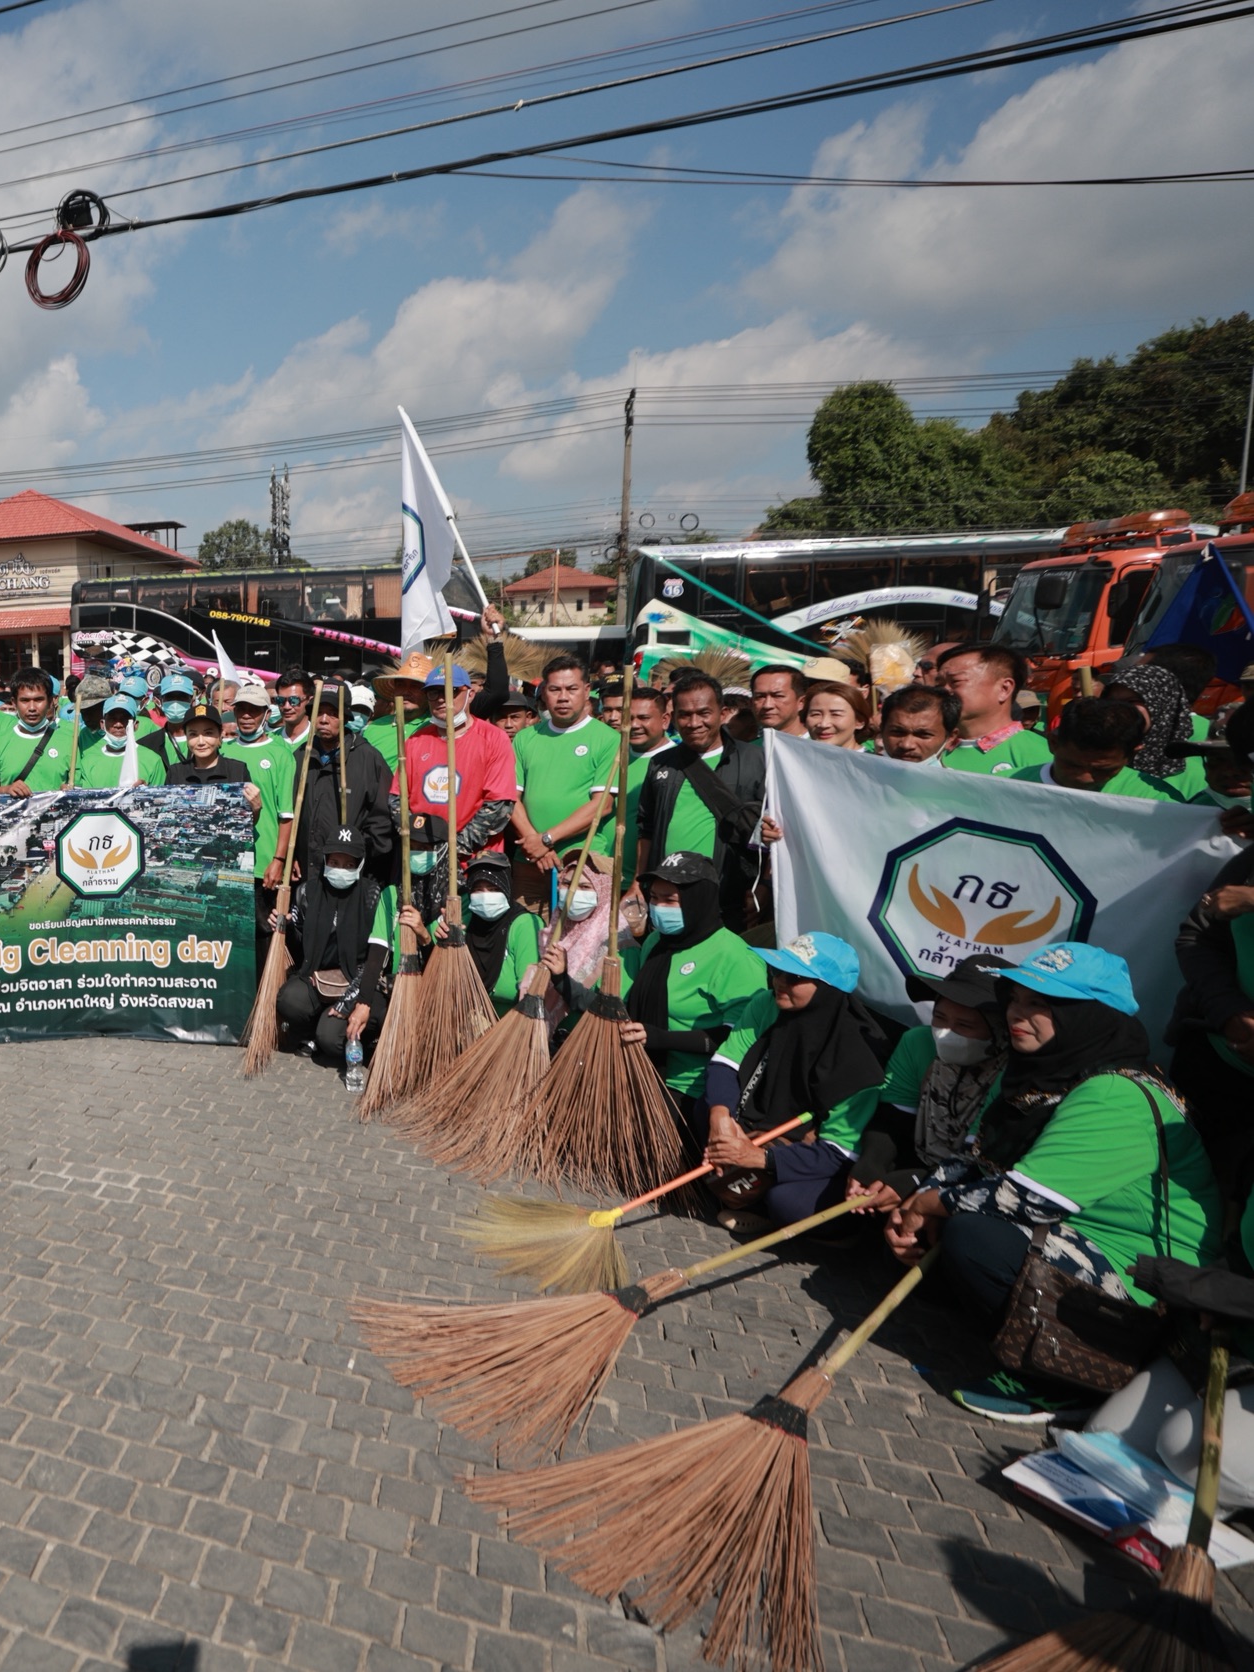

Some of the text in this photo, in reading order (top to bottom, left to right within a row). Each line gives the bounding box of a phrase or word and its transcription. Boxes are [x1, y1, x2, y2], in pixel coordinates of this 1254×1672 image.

[665, 584, 681, 596] 16
[209, 610, 271, 627] 088-7907148
[89, 835, 114, 850] กธ
[87, 867, 116, 875] KLATHAM
[82, 875, 118, 886] กล้าธรรม
[952, 875, 1020, 909] กธ
[29, 916, 176, 930] ขอเรียนเชิญสมาชิกพรรคกล้าธรรม
[936, 930, 1004, 955] KLATHAM
[28, 933, 171, 968] Cleanning
[177, 935, 233, 970] day
[77, 973, 218, 990] ร่วมใจทำความสะอาด
[15, 992, 114, 1012] อำเภอหาดใหญ่
[119, 994, 214, 1010] จังหวัดสงขลา
[727, 1173, 758, 1195] FILA
